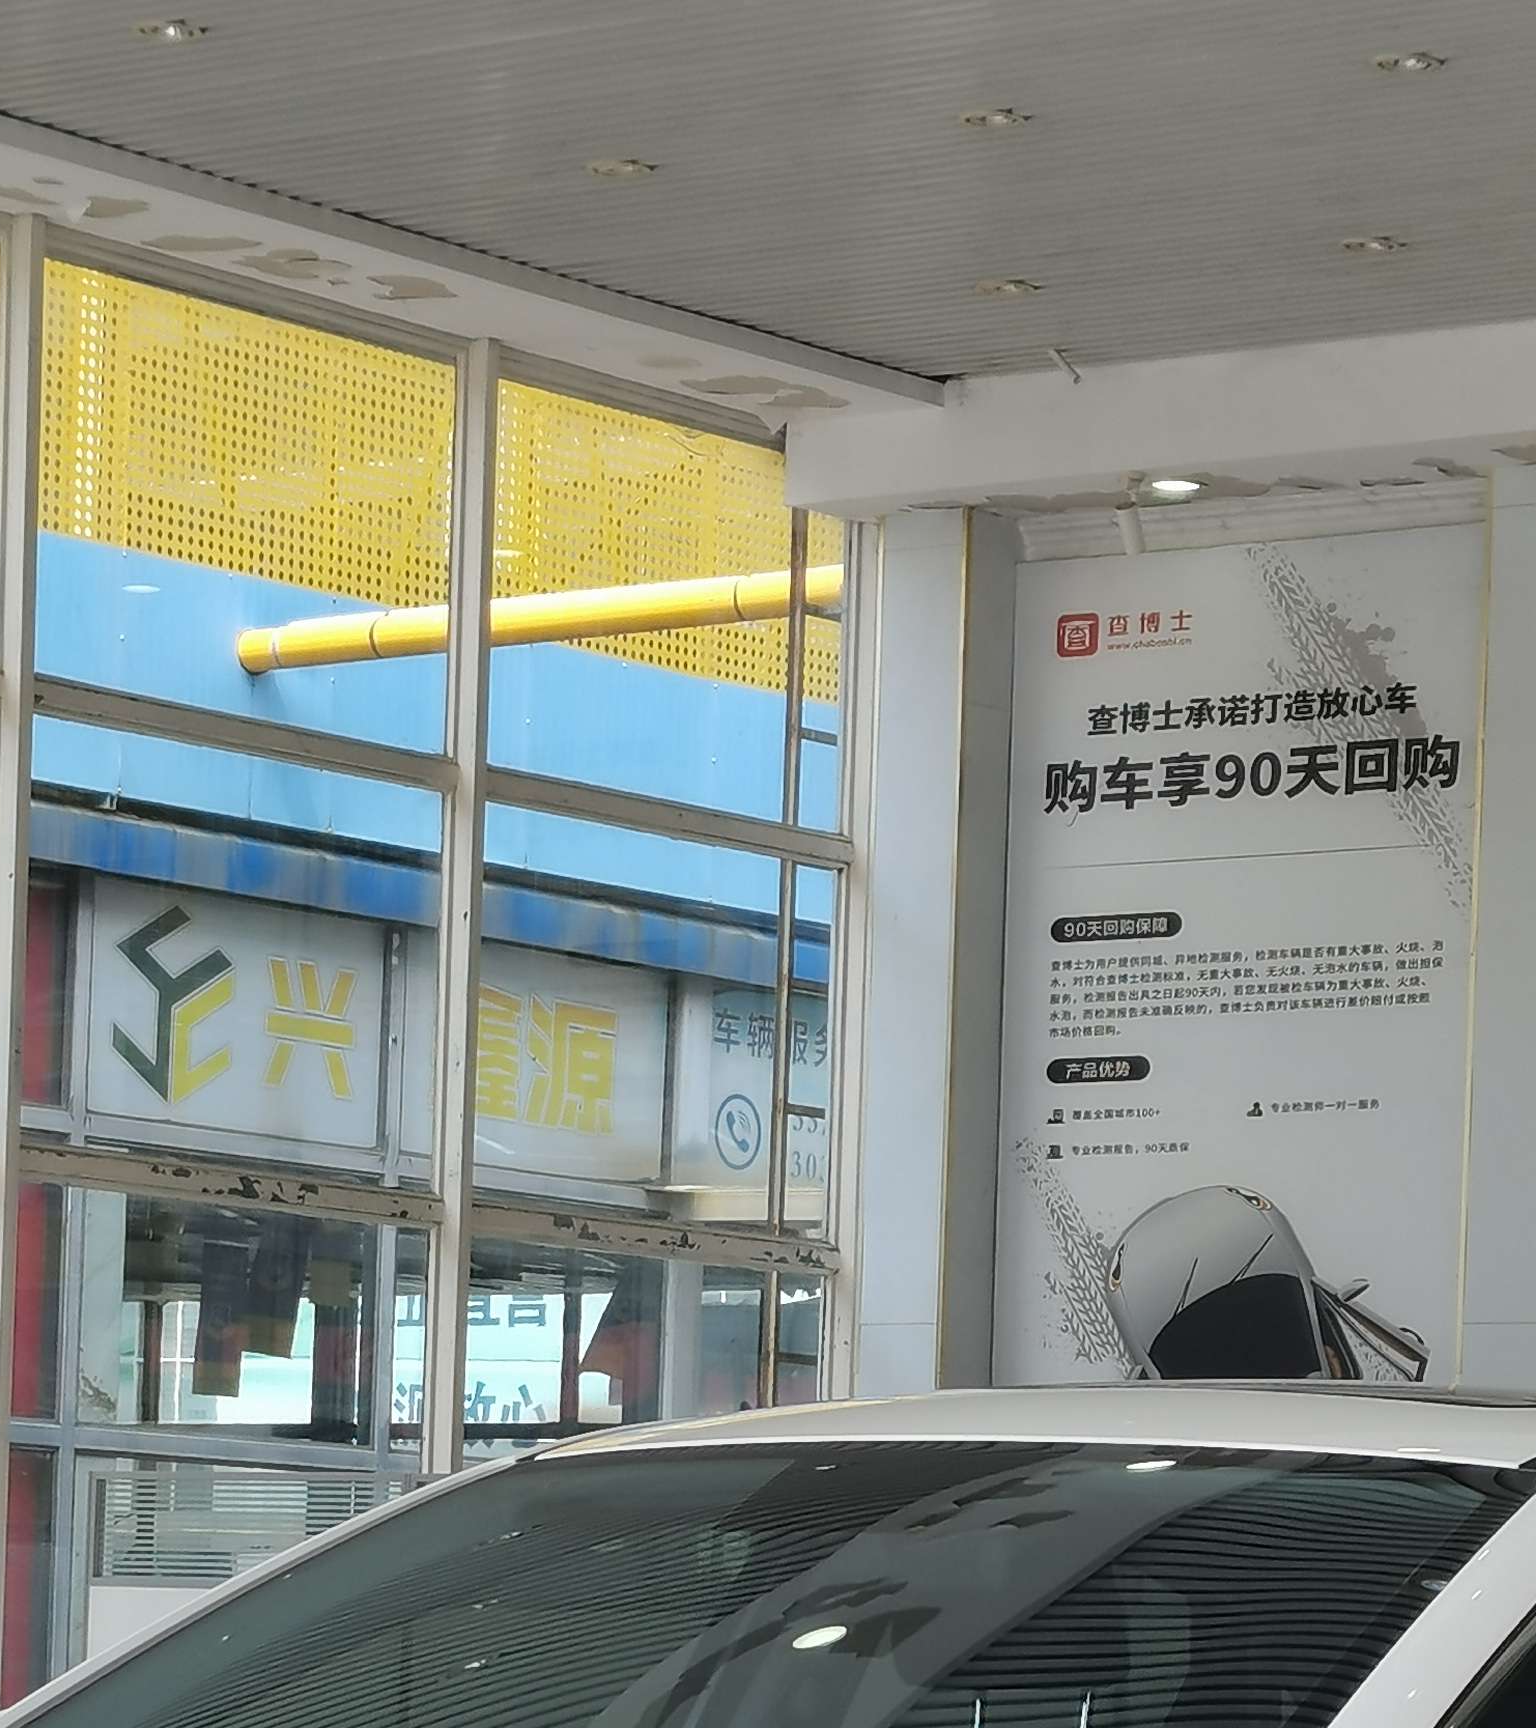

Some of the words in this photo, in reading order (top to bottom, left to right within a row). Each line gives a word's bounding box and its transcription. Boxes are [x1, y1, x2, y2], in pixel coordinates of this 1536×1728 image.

[1107, 609, 1193, 637] 查博士
[1087, 682, 1418, 736] 查博士承诺打造放心车
[1043, 734, 1461, 815] 购车享90天回购
[1064, 916, 1168, 938] 90天回购保障
[1066, 1060, 1131, 1080] 产品优势
